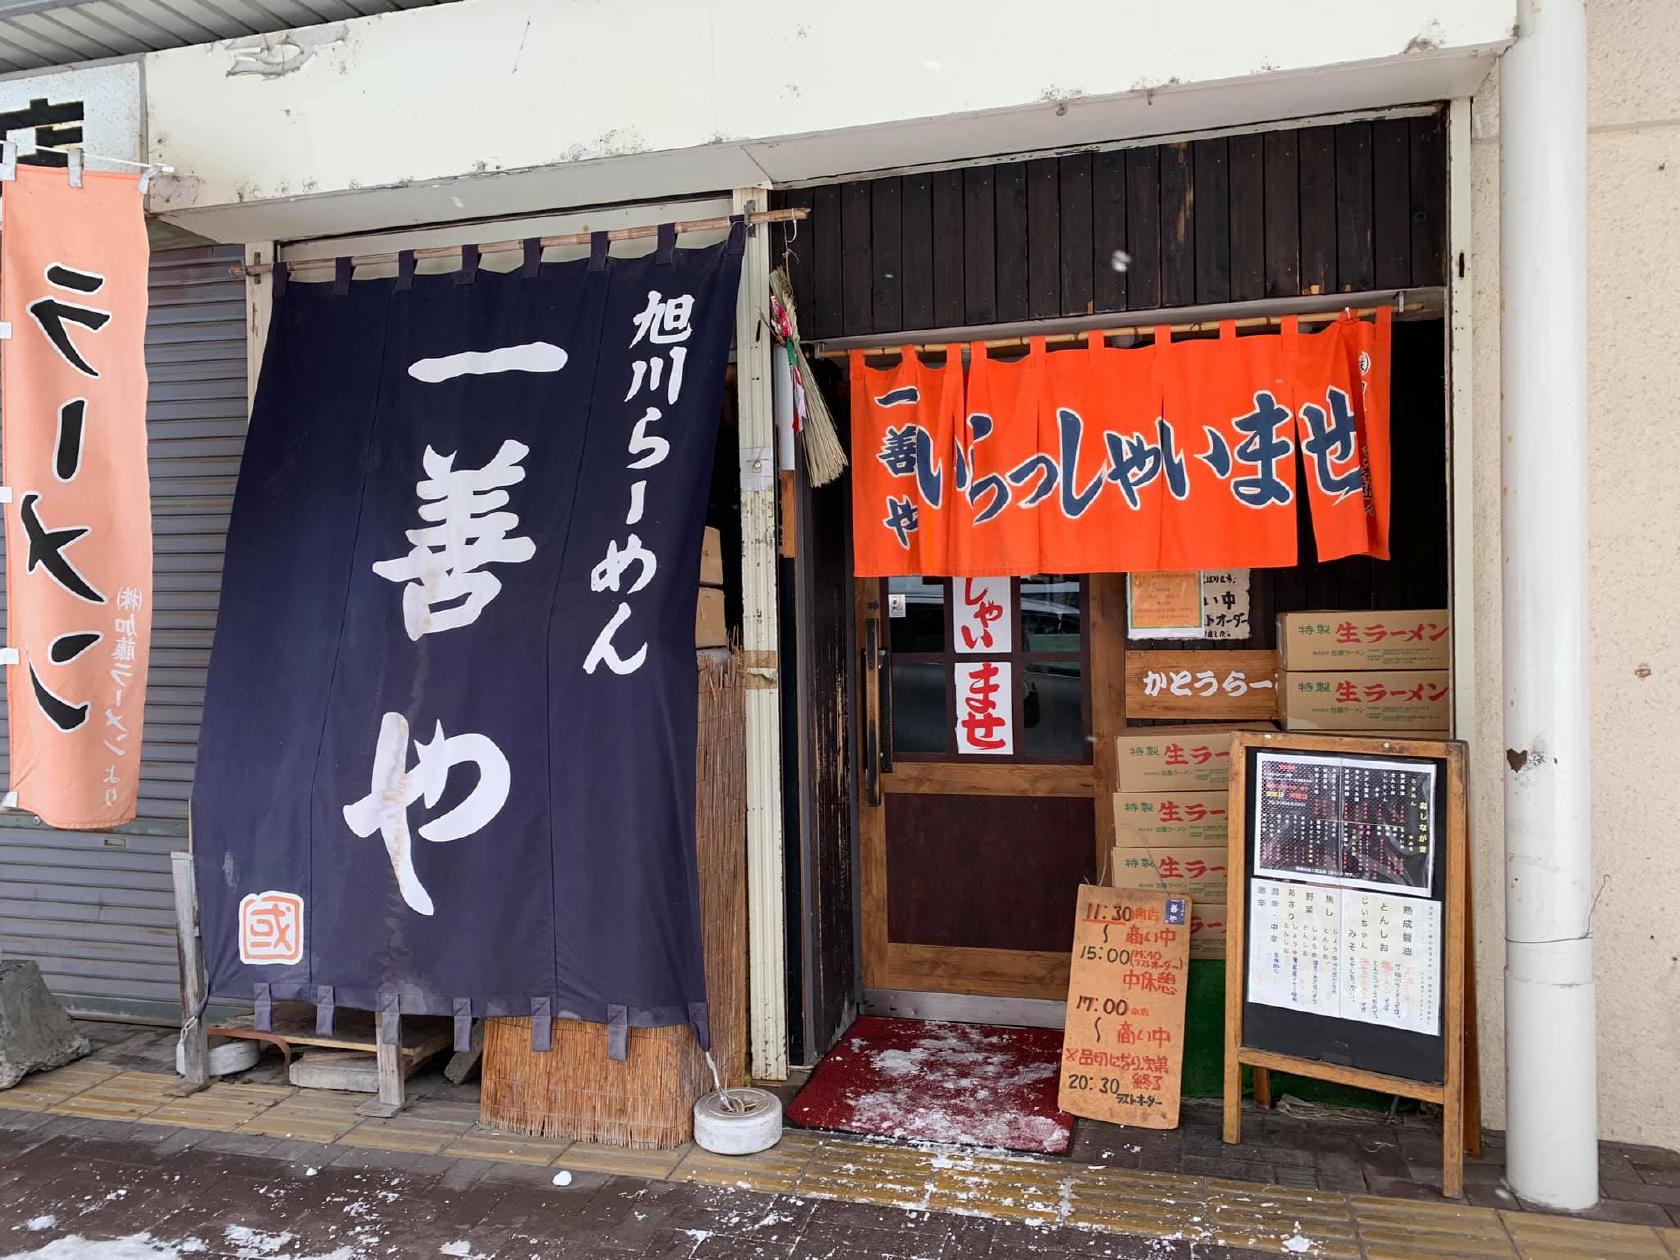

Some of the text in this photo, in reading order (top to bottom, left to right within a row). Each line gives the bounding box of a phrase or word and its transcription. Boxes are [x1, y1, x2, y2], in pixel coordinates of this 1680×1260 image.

[915, 385, 1364, 526] いらっしゃいませ
[583, 290, 695, 674] 旭川らーめん
[343, 341, 568, 916] 一善や
[1298, 621, 1449, 643] 特製 生ラーメン
[1143, 670, 1278, 697] かとうらー
[1298, 680, 1449, 703] 特製 生ラーメン
[961, 662, 1006, 750] ませ
[1158, 801, 1228, 822] 生ラー
[1158, 856, 1228, 878] 生ラー
[1086, 902, 1132, 922] 11:30
[1360, 897, 1369, 950] じいちゃん
[1126, 924, 1176, 948] 商い中
[1380, 902, 1389, 952] とんしお
[1348, 930, 1357, 951] みそ
[1080, 945, 1130, 965] 15:00
[1123, 969, 1178, 995] 中休憩
[1076, 995, 1128, 1016] 17:00
[1117, 1021, 1171, 1049] 商い中
[1068, 1074, 1119, 1094] 20:30
